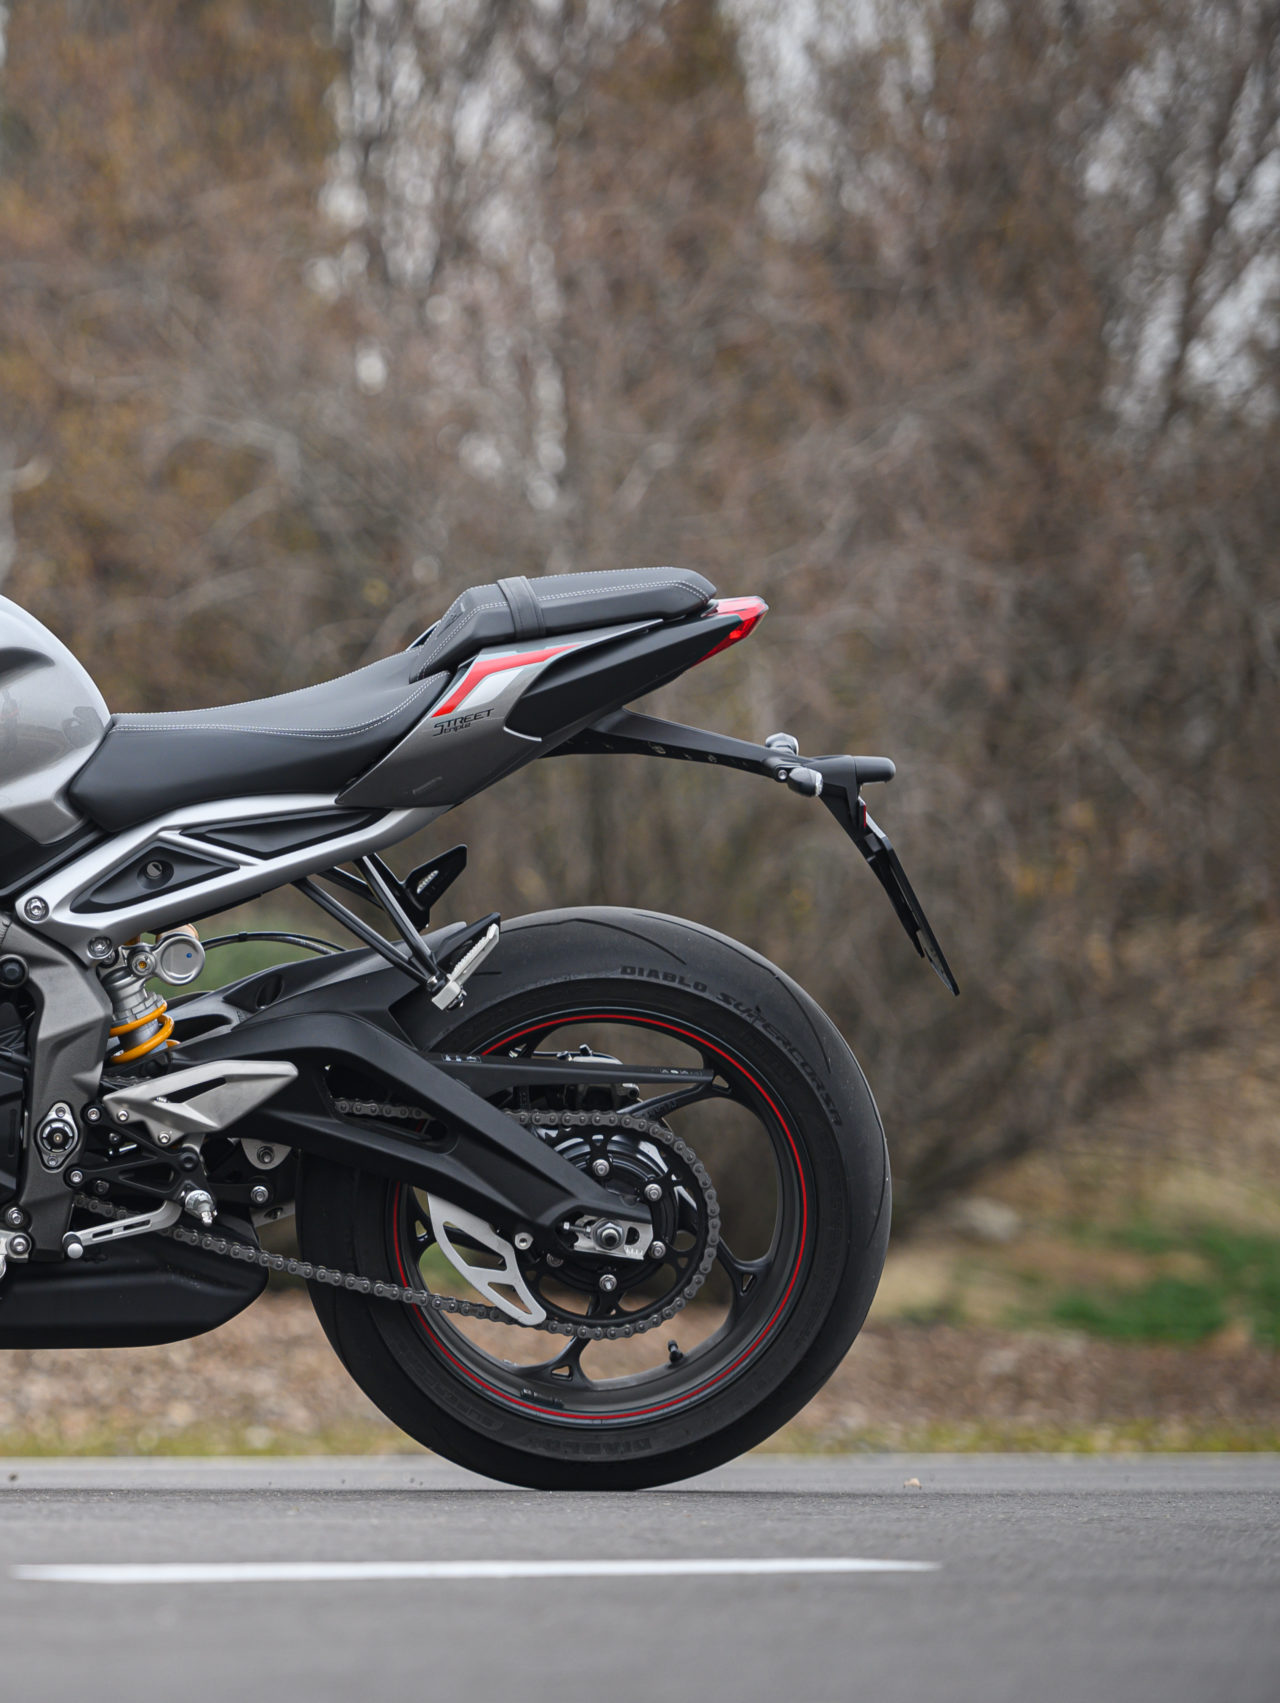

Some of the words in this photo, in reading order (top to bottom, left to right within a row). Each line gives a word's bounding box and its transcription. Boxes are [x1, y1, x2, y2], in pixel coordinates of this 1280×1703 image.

[432, 708, 494, 736] STREET
[444, 722, 472, 734] triple
[621, 965, 708, 992] DIABLO
[716, 991, 844, 1127] SUPERCORSA
